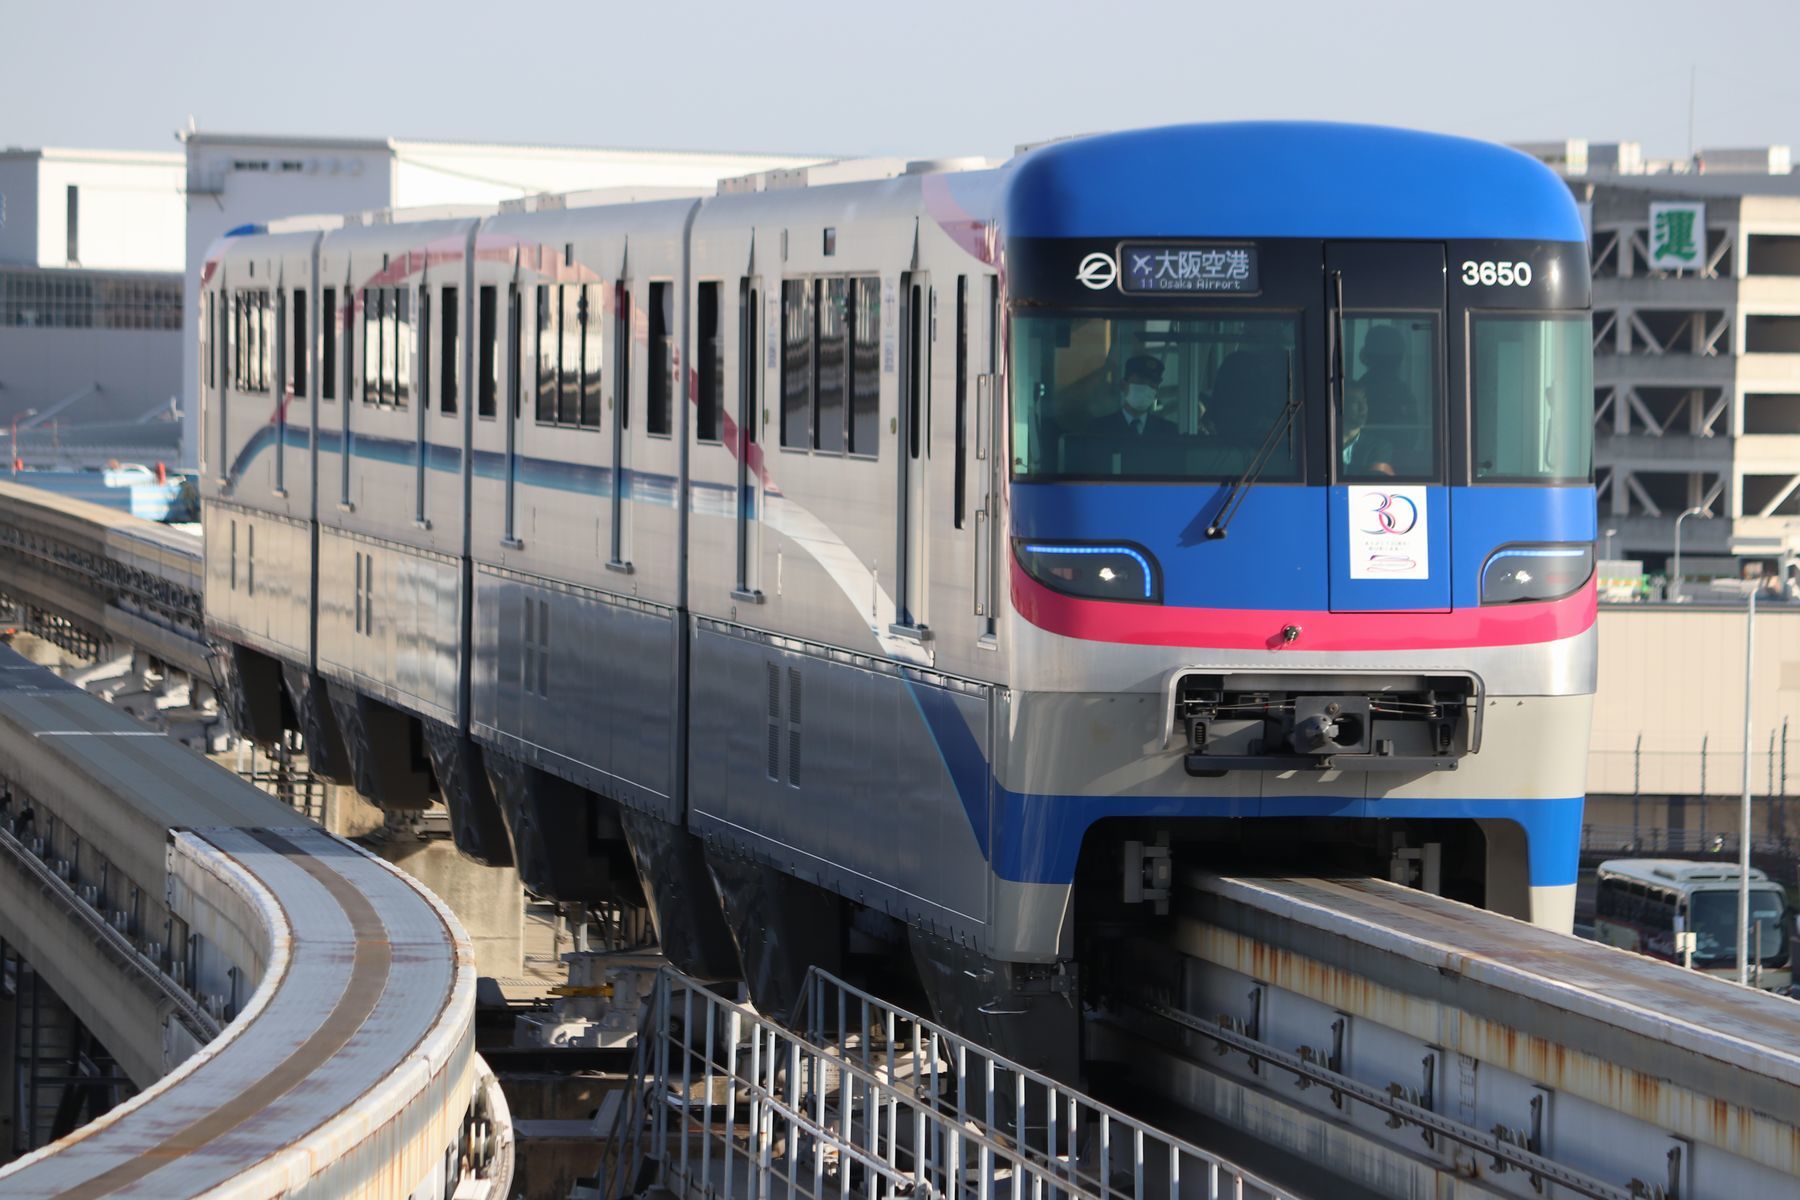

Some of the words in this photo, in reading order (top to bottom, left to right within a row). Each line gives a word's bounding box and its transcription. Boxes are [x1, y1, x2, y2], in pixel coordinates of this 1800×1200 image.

[1155, 250, 1249, 279] 大阪空港
[1462, 260, 1532, 287] 3650
[1160, 279, 1192, 289] Osaka
[1197, 279, 1241, 290] Airport
[1360, 492, 1418, 535] 30
